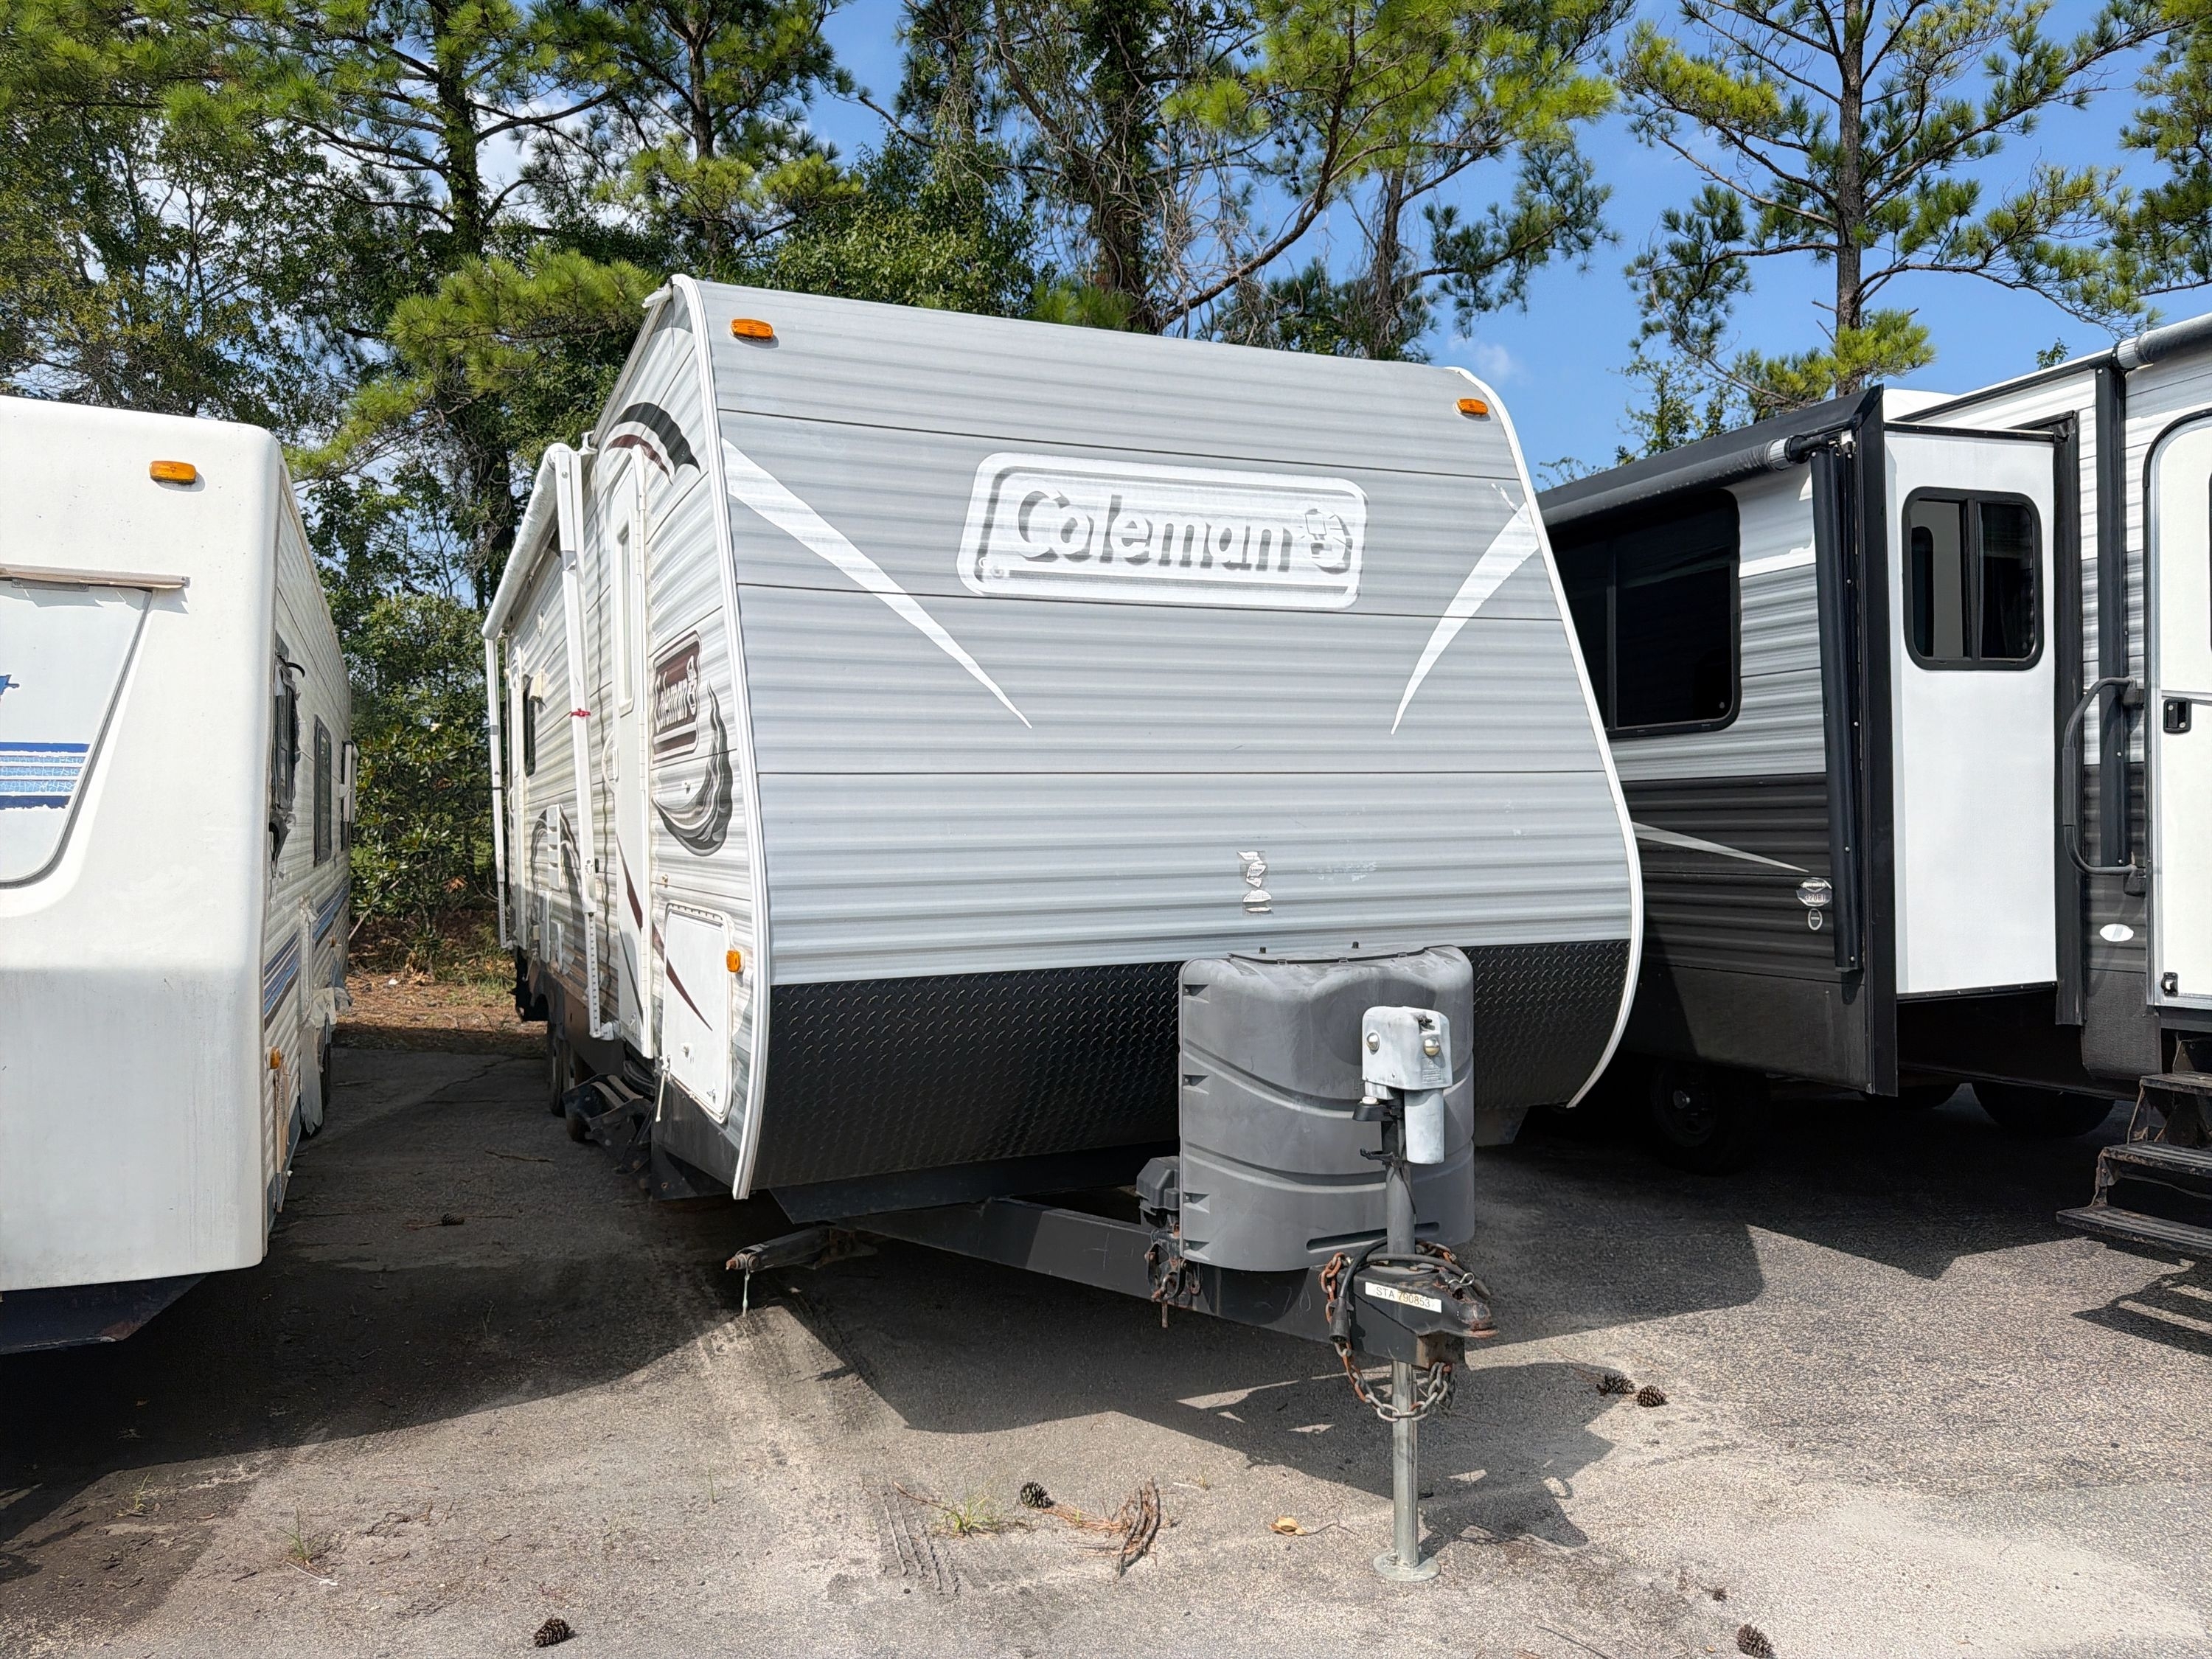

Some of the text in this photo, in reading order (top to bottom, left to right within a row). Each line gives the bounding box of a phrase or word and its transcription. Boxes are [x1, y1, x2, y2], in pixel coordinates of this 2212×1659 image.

[1017, 484, 1294, 573] Coleman
[654, 671, 688, 734] Coleman
[1376, 1286, 1430, 1308] STA 790853
